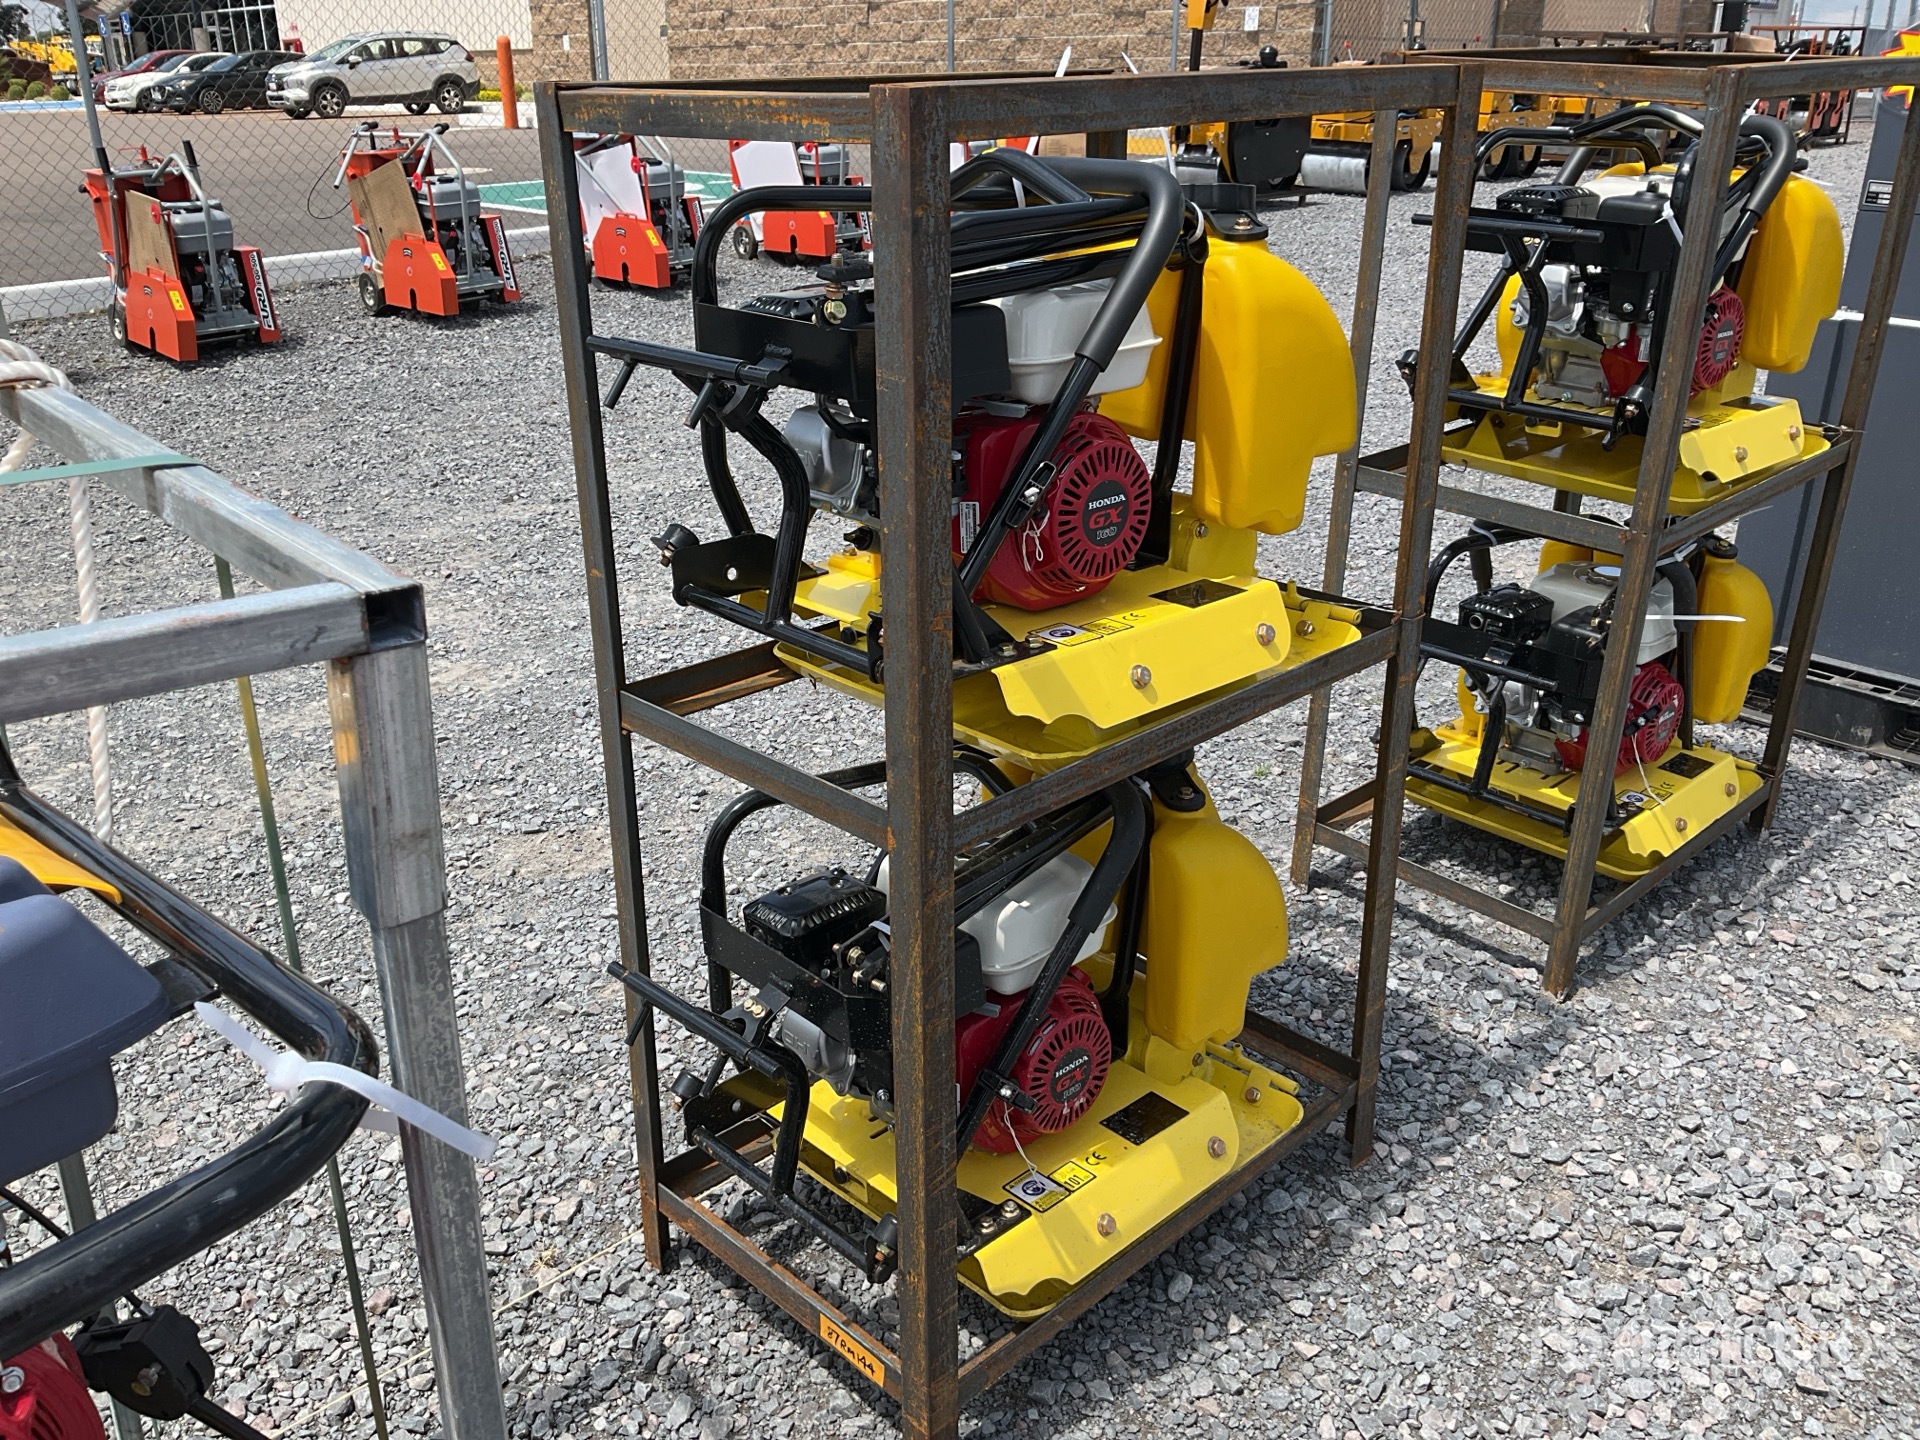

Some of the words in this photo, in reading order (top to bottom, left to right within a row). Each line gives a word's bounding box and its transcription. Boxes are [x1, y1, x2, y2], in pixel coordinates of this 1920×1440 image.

[1088, 494, 1126, 510] HONDA
[1089, 506, 1124, 529] GX
[1096, 526, 1117, 540] 160
[1055, 1055, 1089, 1078] HONDA
[1056, 1065, 1087, 1092] GX
[1064, 1174, 1084, 1188] 101
